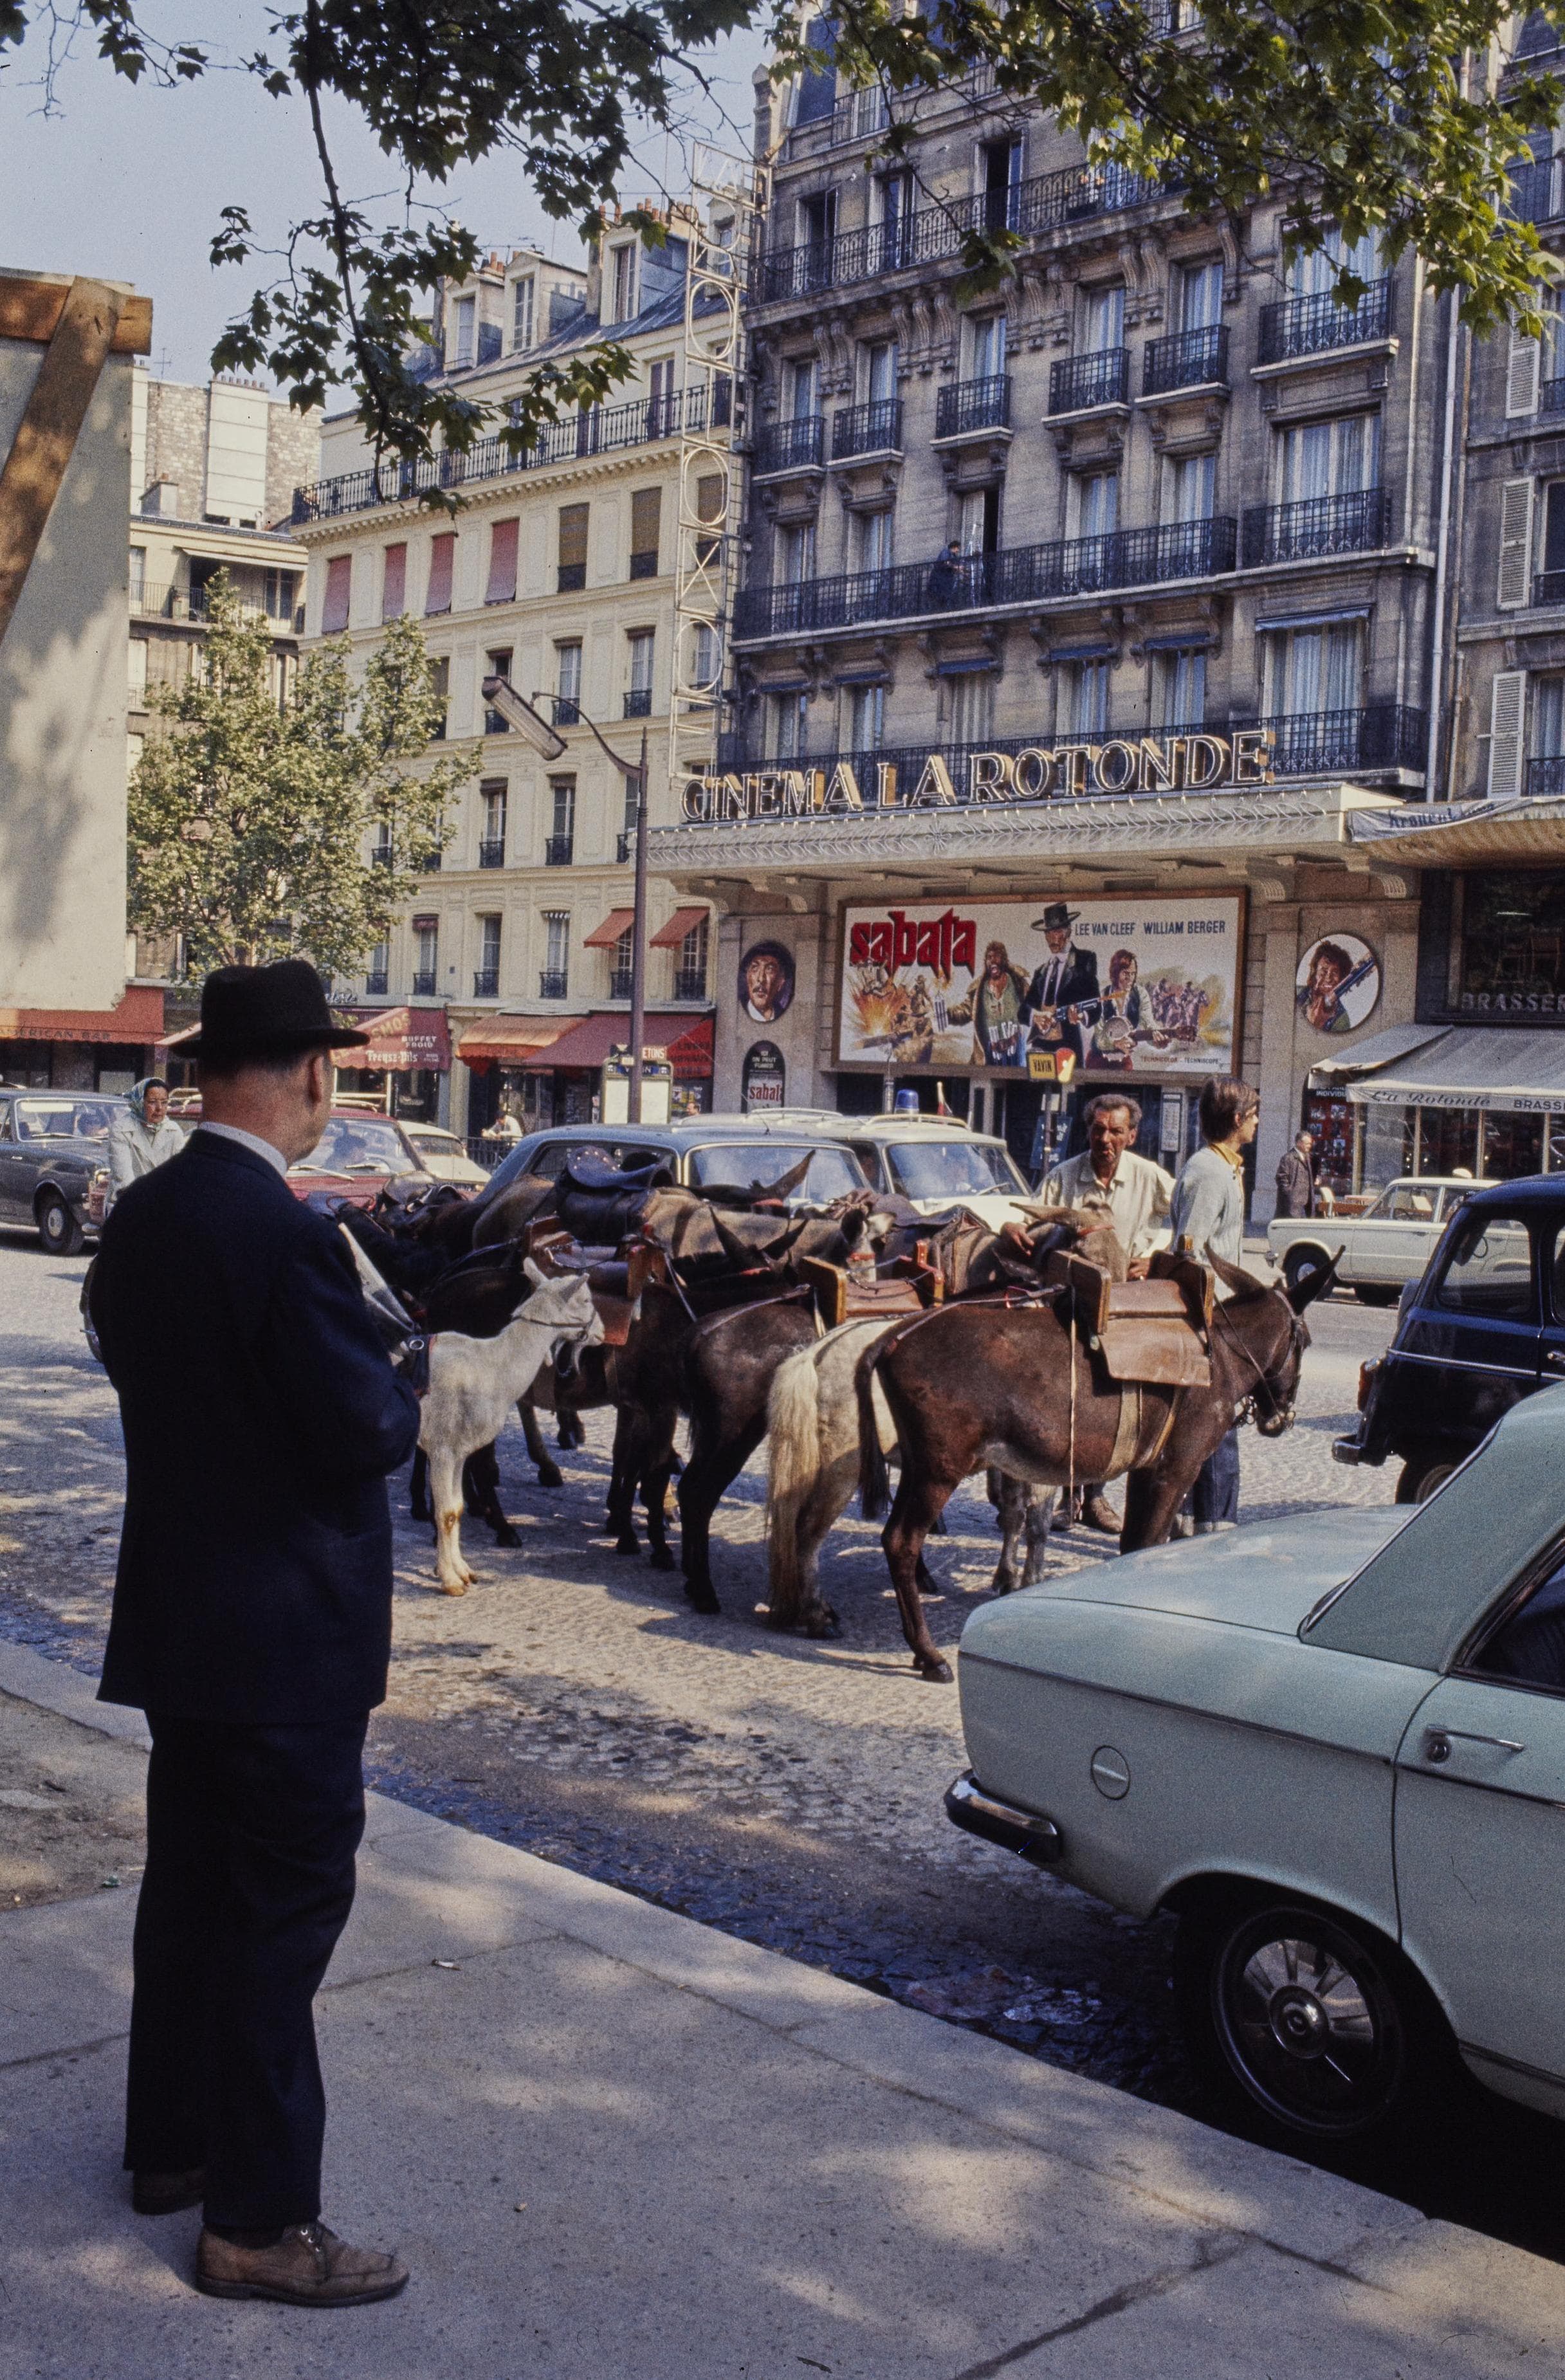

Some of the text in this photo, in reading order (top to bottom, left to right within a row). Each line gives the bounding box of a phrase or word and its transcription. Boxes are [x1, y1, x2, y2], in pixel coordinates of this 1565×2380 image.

[680, 731, 1274, 822] CINEMA LA ROTONDE
[1075, 920, 1225, 936] LEE VAN CLEEF WILLIAM BERGER
[849, 907, 976, 982] sabata
[82, 1031, 110, 1040] BAR
[642, 1047, 665, 1059] ETONS
[1034, 1059, 1052, 1072] VAVIN
[1514, 1099, 1565, 1111] BRASS
